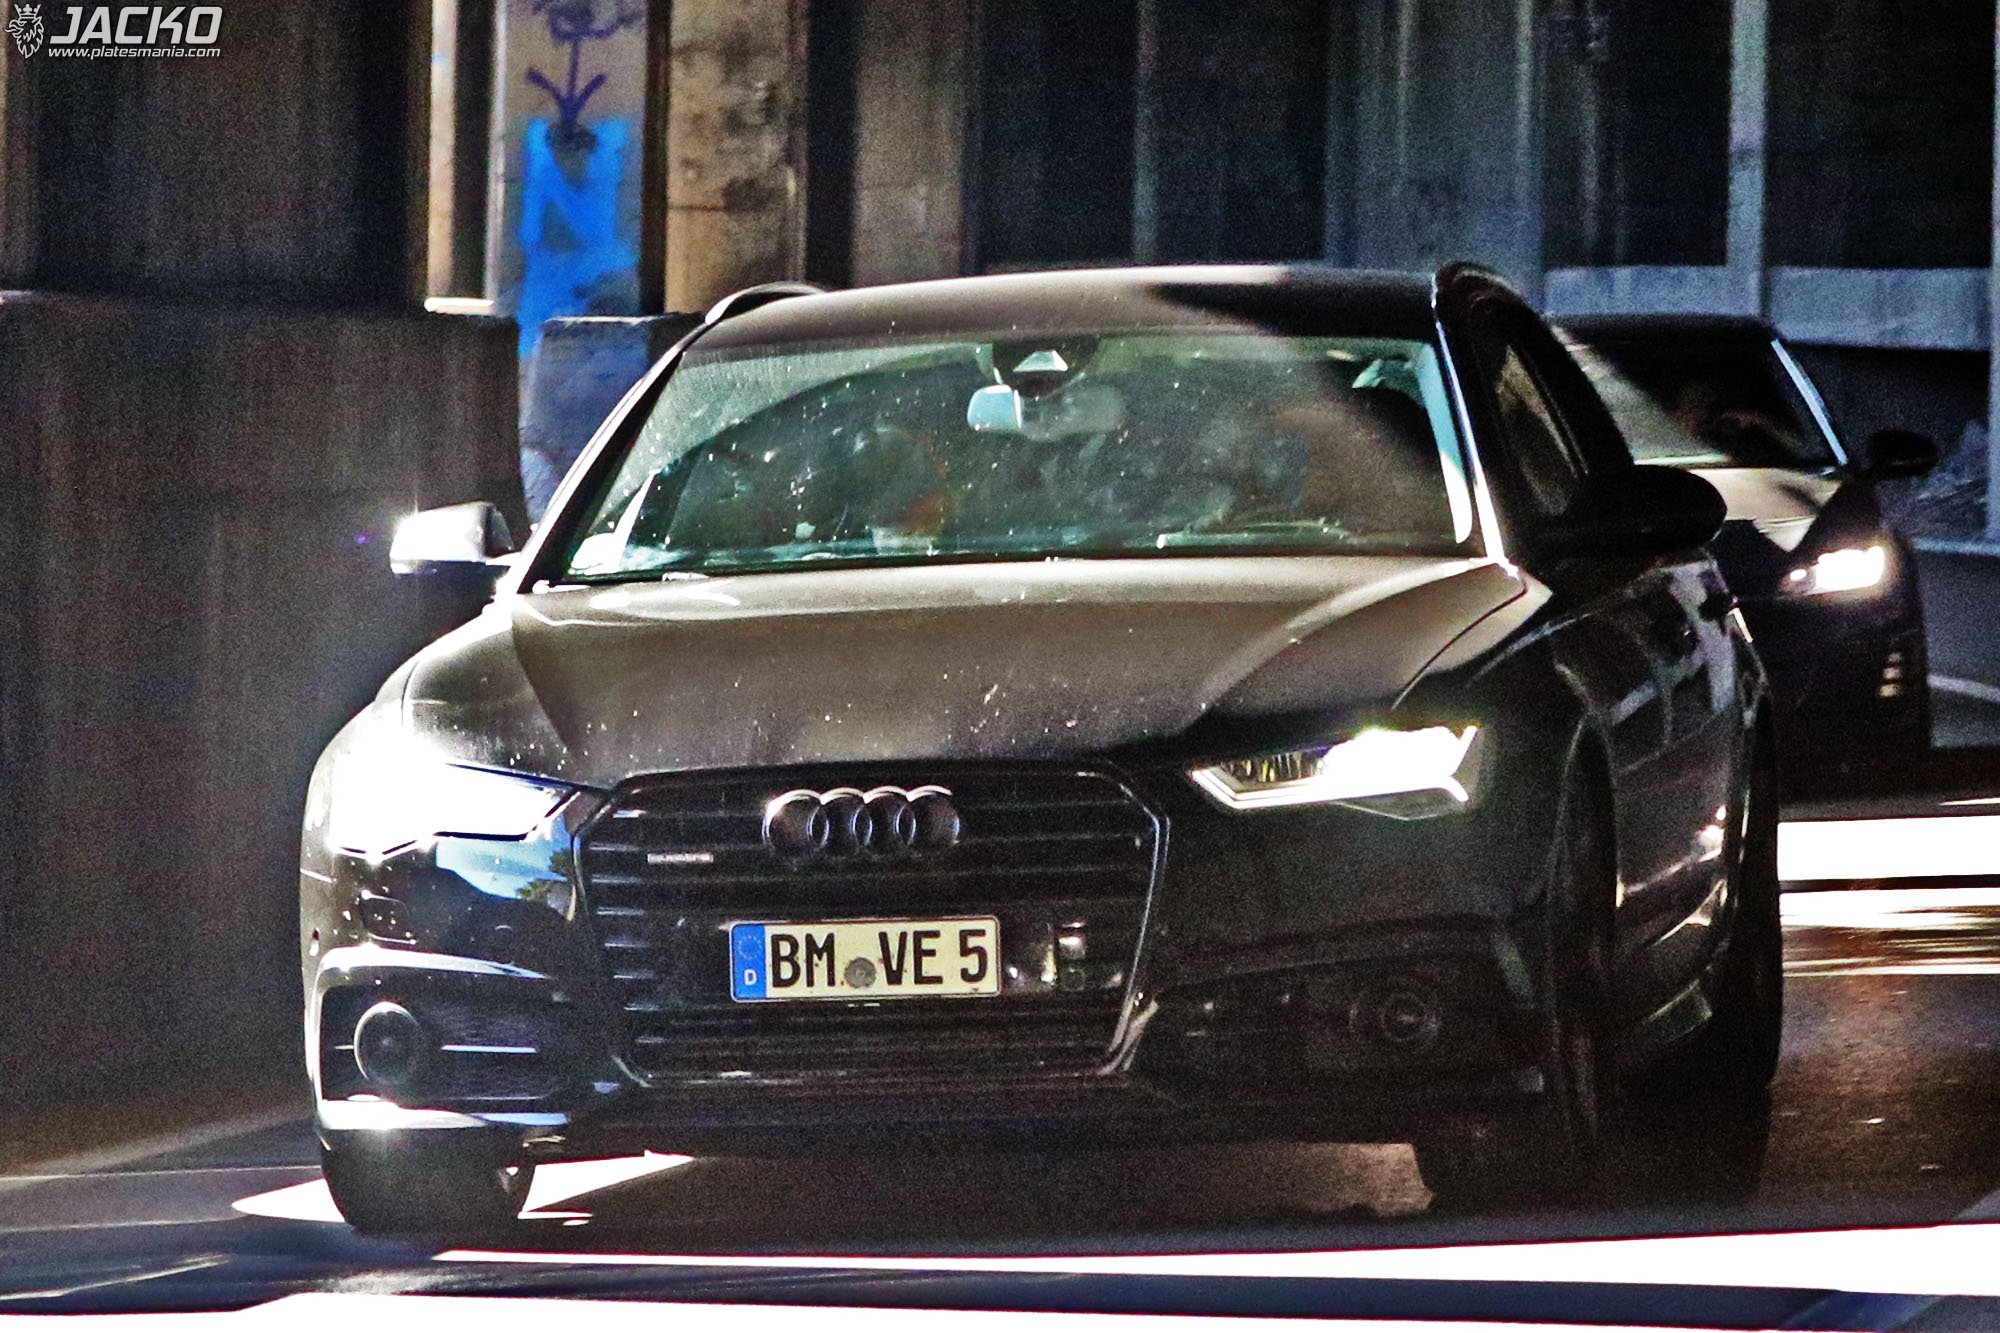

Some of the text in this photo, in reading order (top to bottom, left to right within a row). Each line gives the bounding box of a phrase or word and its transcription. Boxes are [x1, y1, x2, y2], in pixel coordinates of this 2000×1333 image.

[743, 969, 757, 986] D
[771, 929, 987, 988] BM VE 5
